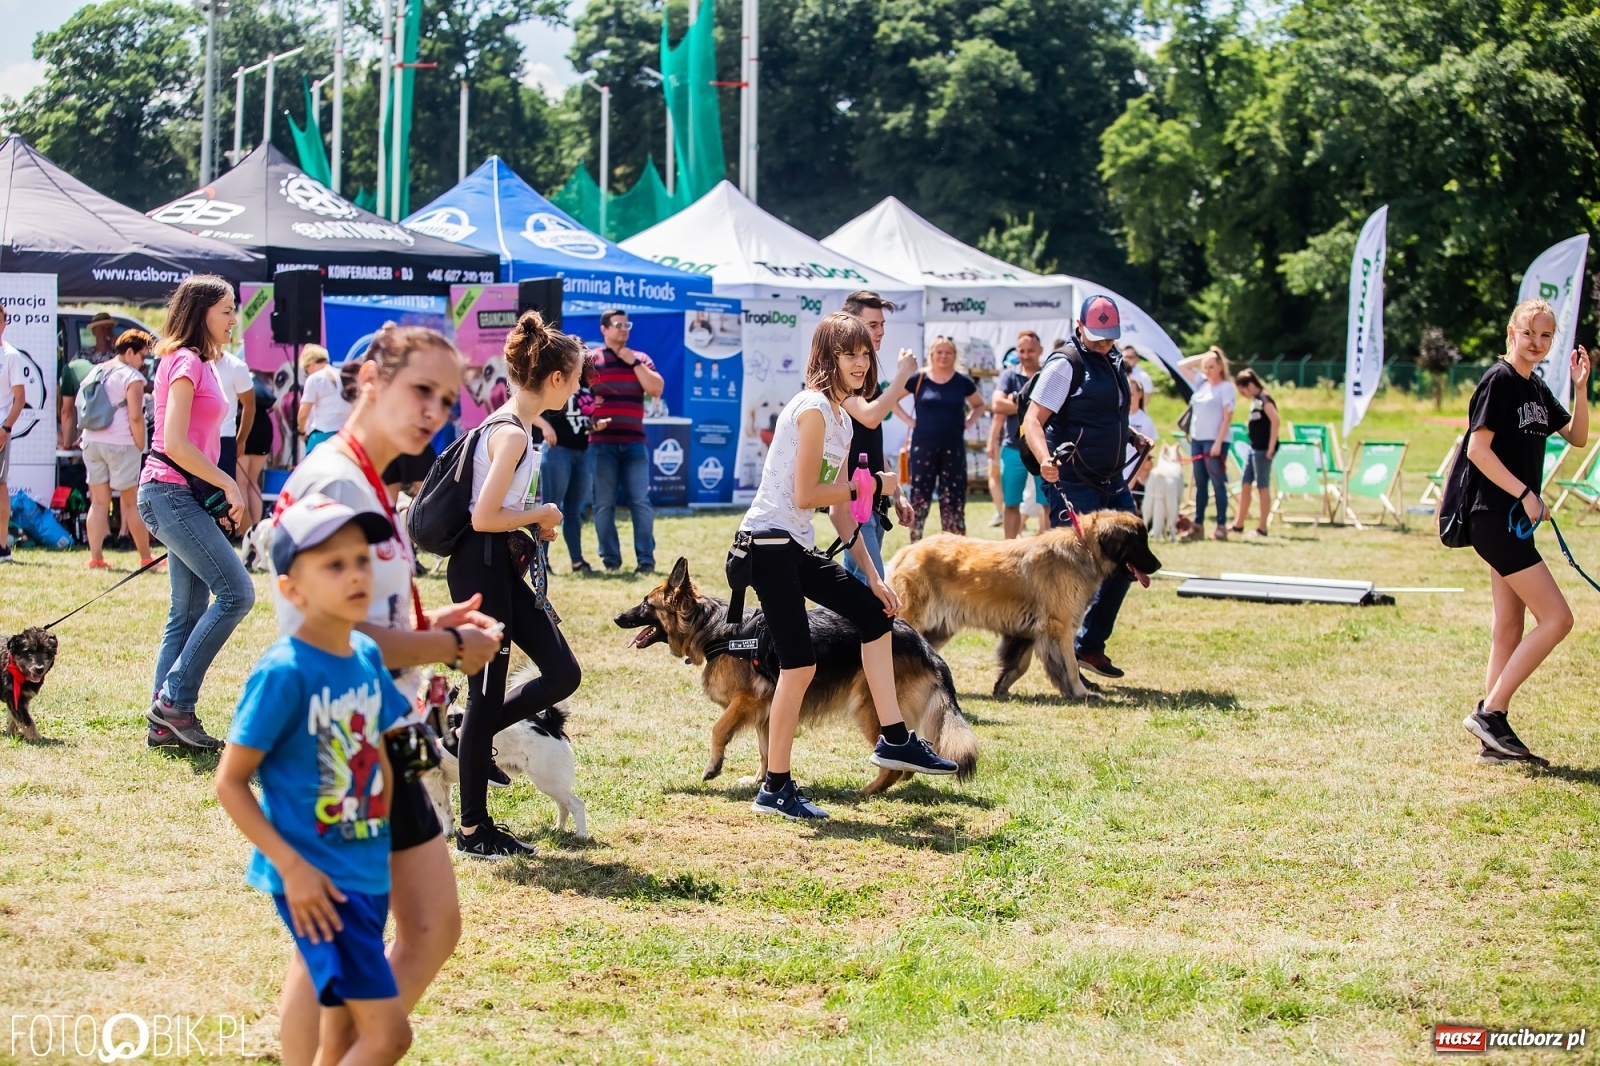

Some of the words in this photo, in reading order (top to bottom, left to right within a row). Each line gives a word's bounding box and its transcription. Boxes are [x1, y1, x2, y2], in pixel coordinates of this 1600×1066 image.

[328, 265, 393, 281] KONFERANSJER
[401, 267, 414, 281] DJ
[753, 262, 868, 283] TropiDog
[615, 276, 636, 298] Pet
[638, 278, 676, 302] Foods
[941, 297, 986, 315] TropiDog
[25, 313, 50, 326] psa
[741, 309, 797, 329] TropiDog
